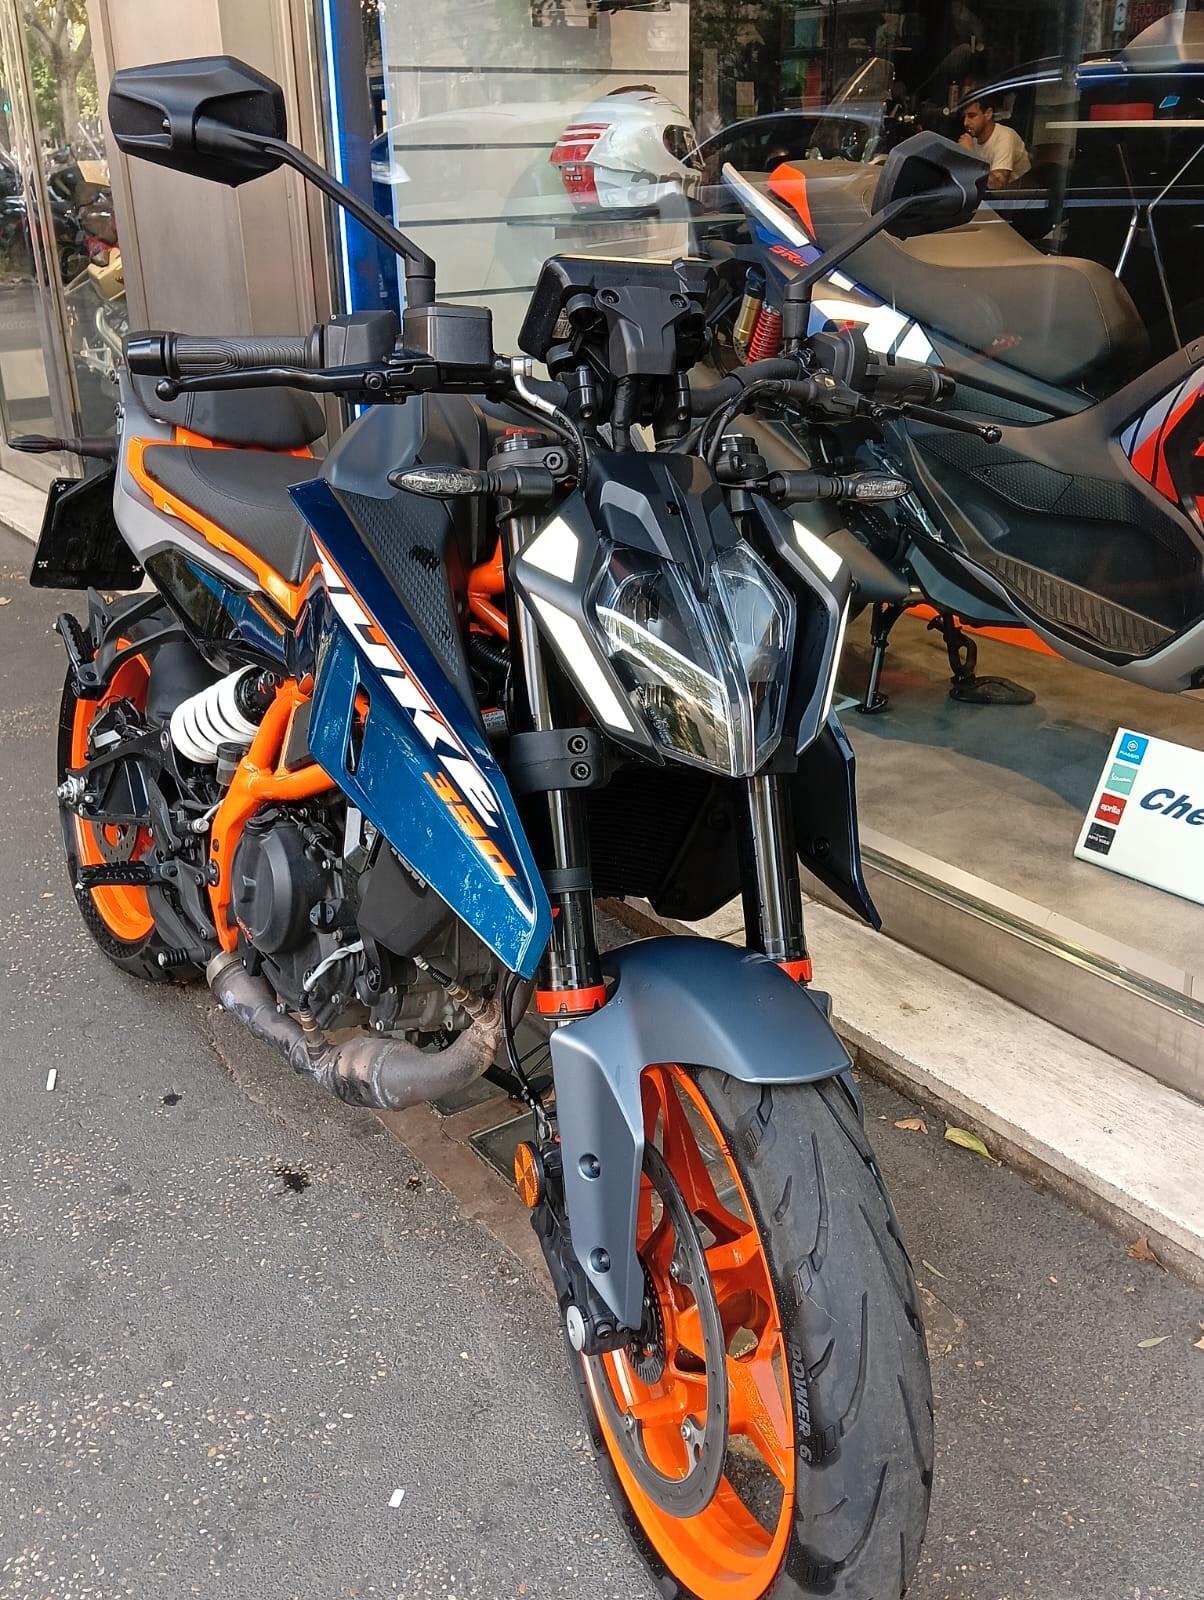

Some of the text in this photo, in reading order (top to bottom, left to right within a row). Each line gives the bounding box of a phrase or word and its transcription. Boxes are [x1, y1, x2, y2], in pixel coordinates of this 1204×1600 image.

[423, 771, 518, 876] 390
[788, 1342, 813, 1462] POWER 6
